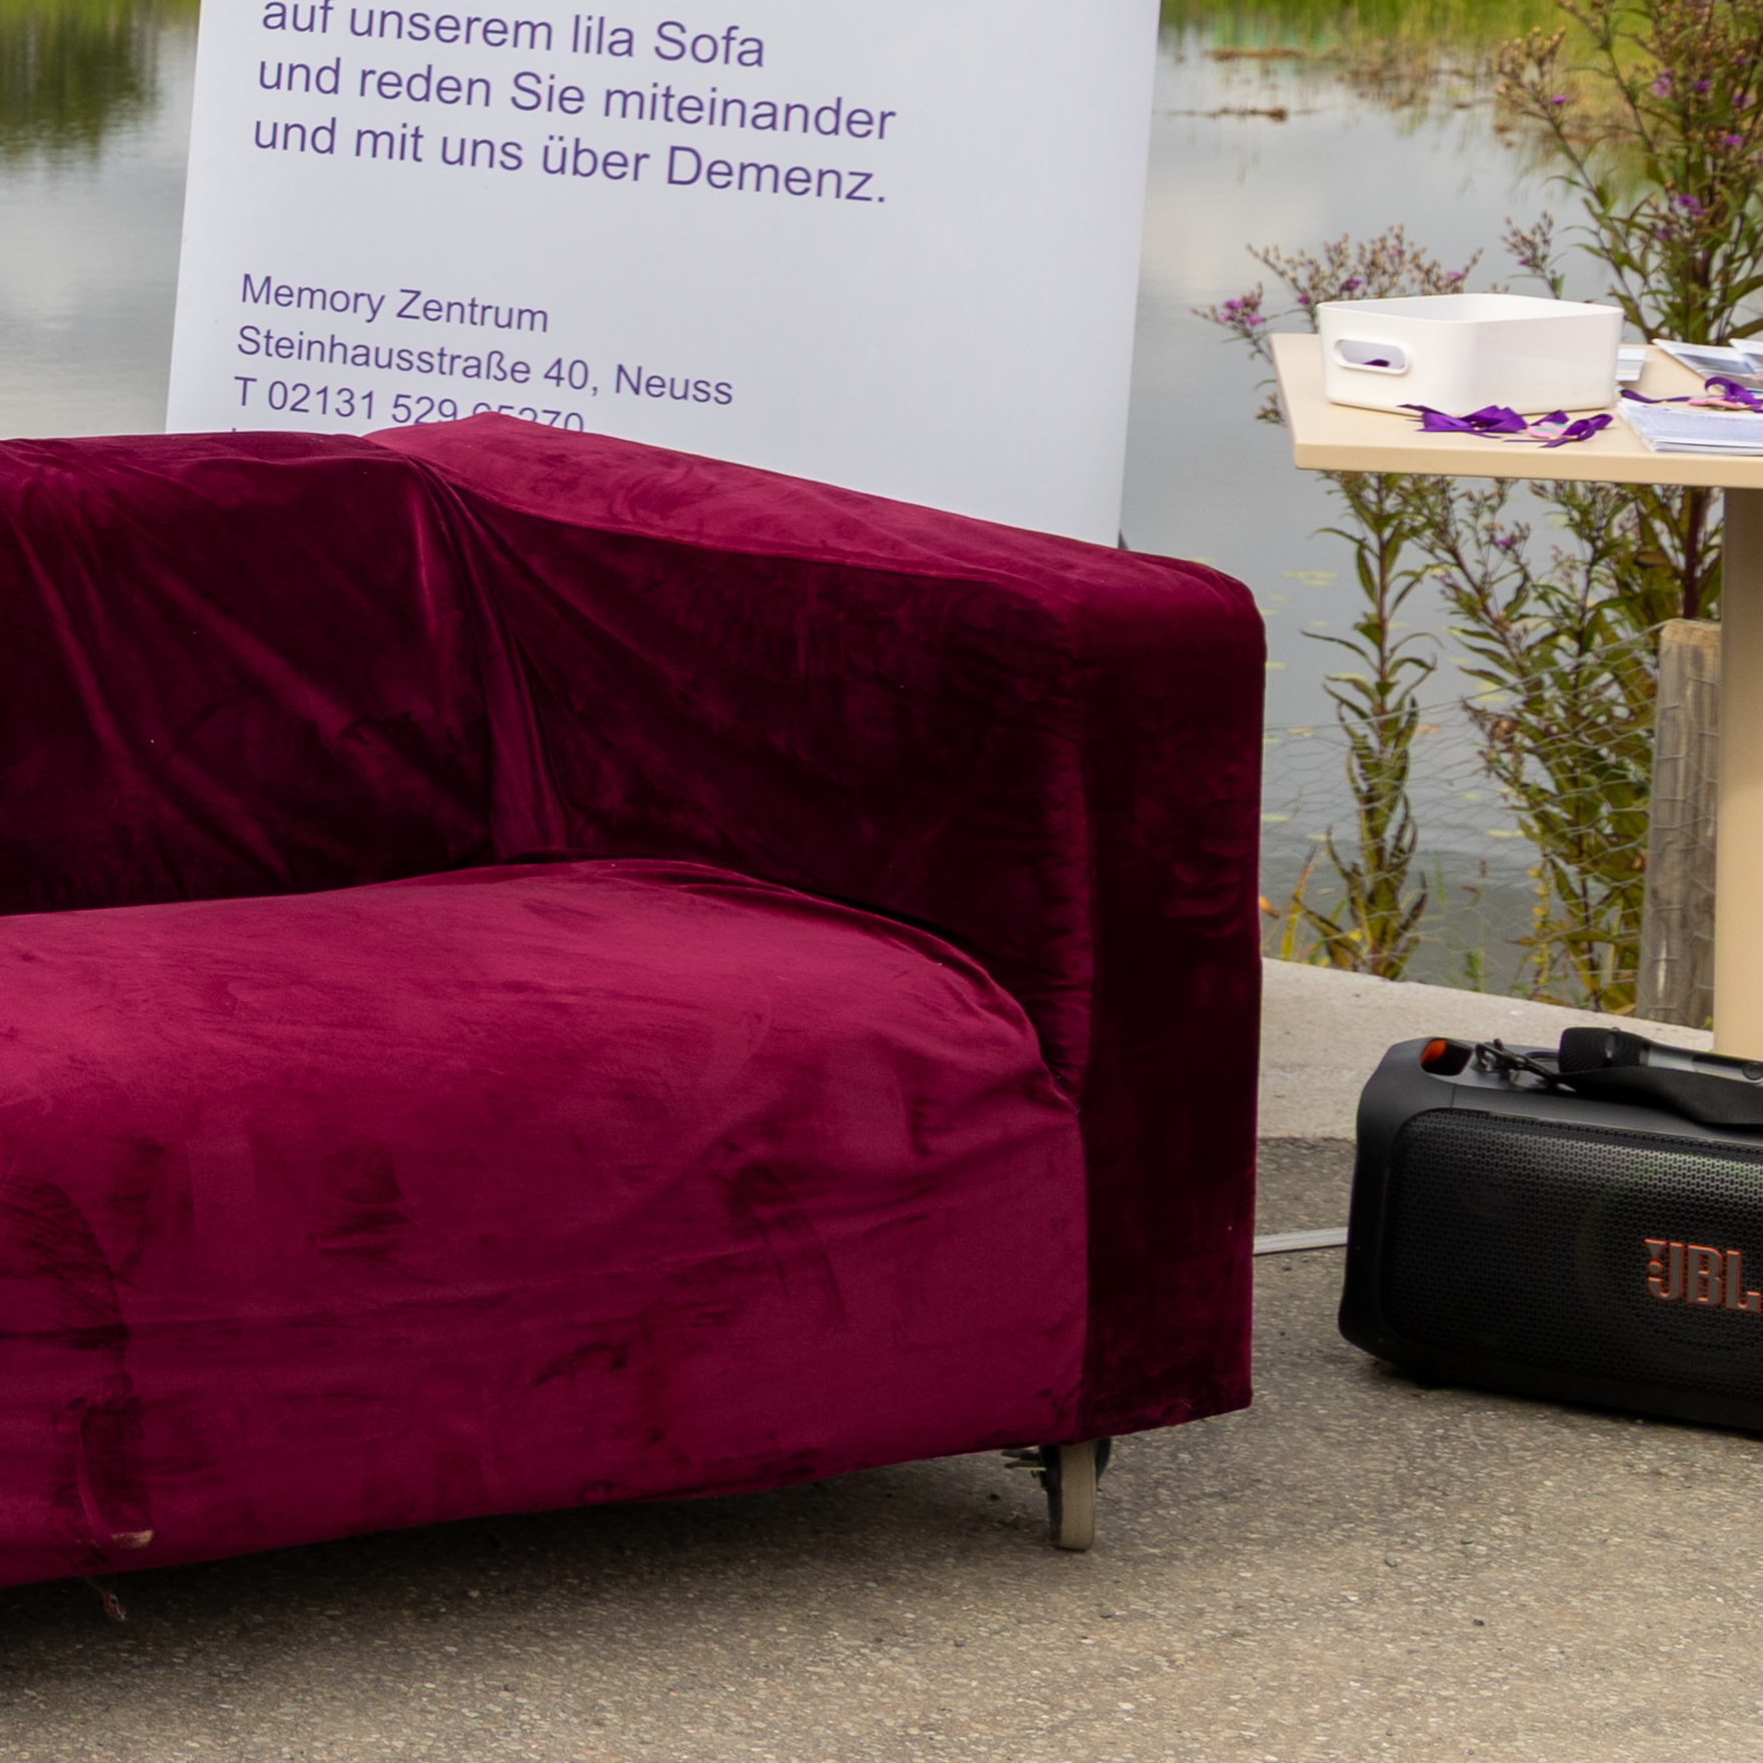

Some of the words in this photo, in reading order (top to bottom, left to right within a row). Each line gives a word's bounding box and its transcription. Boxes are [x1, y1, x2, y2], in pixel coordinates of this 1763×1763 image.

[349, 7, 553, 51] unserem
[572, 14, 634, 58] lila
[654, 20, 764, 68] Sofa
[259, 56, 341, 95] und
[359, 63, 491, 107] reden
[510, 71, 585, 115] Sie
[604, 82, 897, 140] miteinander
[254, 116, 337, 155] und
[355, 122, 424, 163] mit
[441, 136, 523, 171] uns
[542, 134, 651, 182] über
[667, 145, 885, 203] Demenz.
[241, 273, 386, 324] Memory
[396, 288, 548, 333] Zentrum
[234, 375, 258, 407] T
[268, 380, 374, 420] 02131
[391, 393, 458, 425] 529
[237, 325, 531, 384] Steinhausstraße
[543, 357, 598, 397] 40,
[615, 363, 733, 406] Neuss
[1644, 1239, 1761, 1313] JBL
